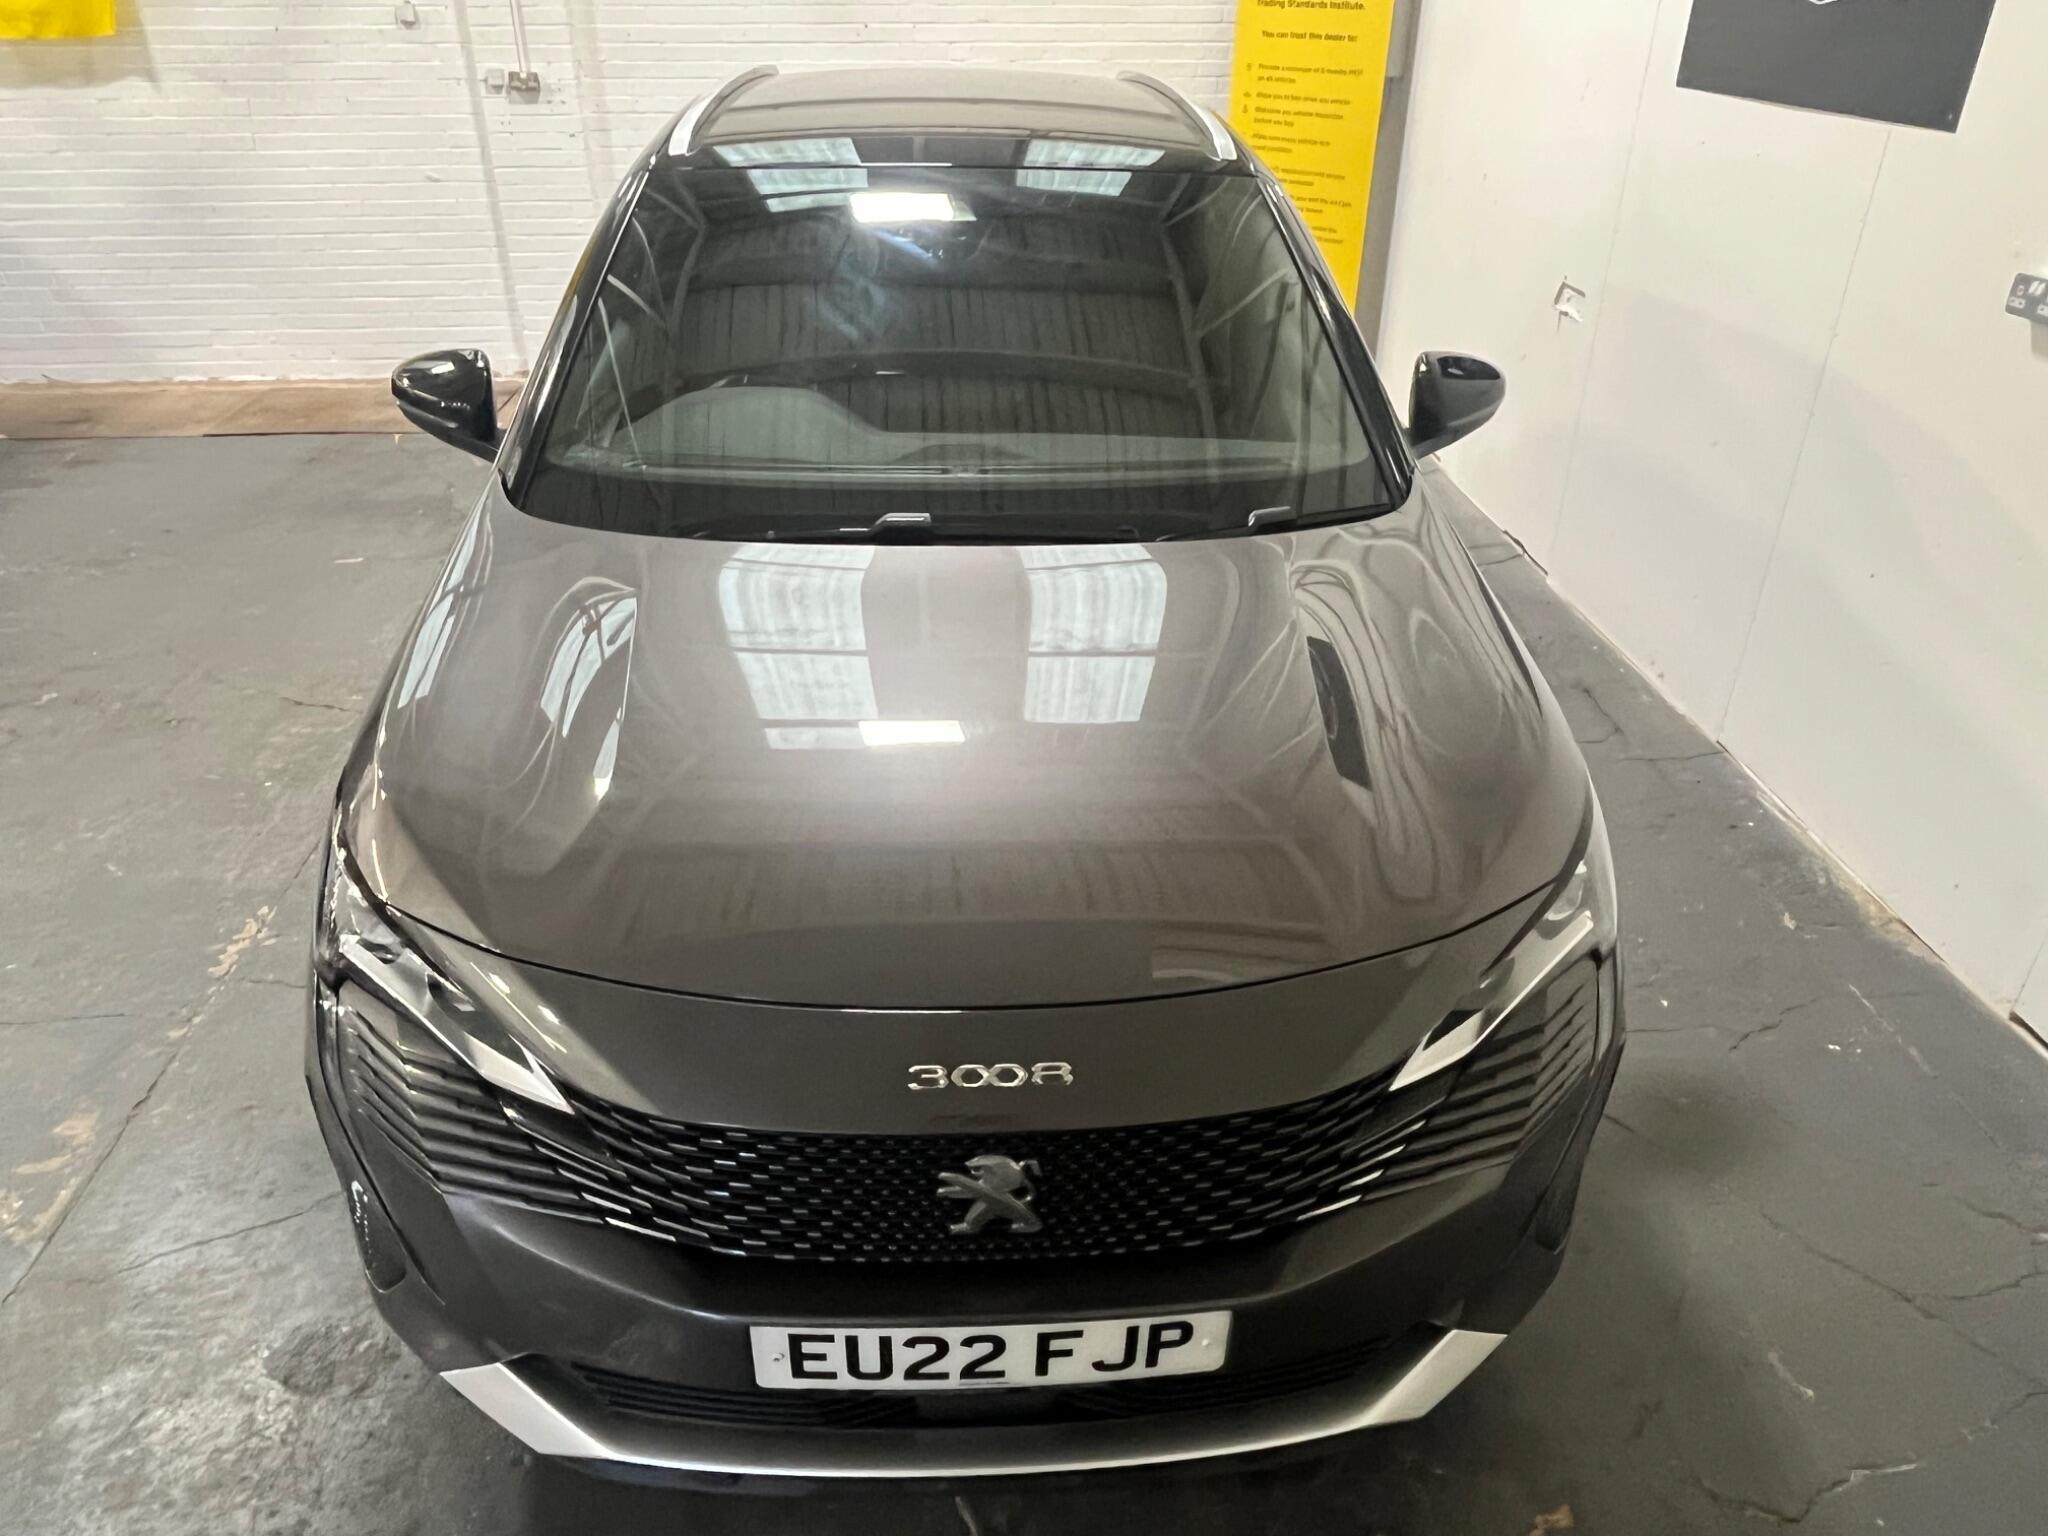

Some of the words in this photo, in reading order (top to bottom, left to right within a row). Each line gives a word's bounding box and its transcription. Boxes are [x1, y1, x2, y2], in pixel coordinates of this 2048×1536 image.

[1287, 0, 1328, 9] Standards
[1261, 30, 1275, 38] You
[1276, 31, 1289, 39] can
[1290, 31, 1307, 40] trust
[1308, 32, 1323, 40] this
[787, 1333, 1006, 1381] EU22
[1034, 1320, 1194, 1377] FJP
